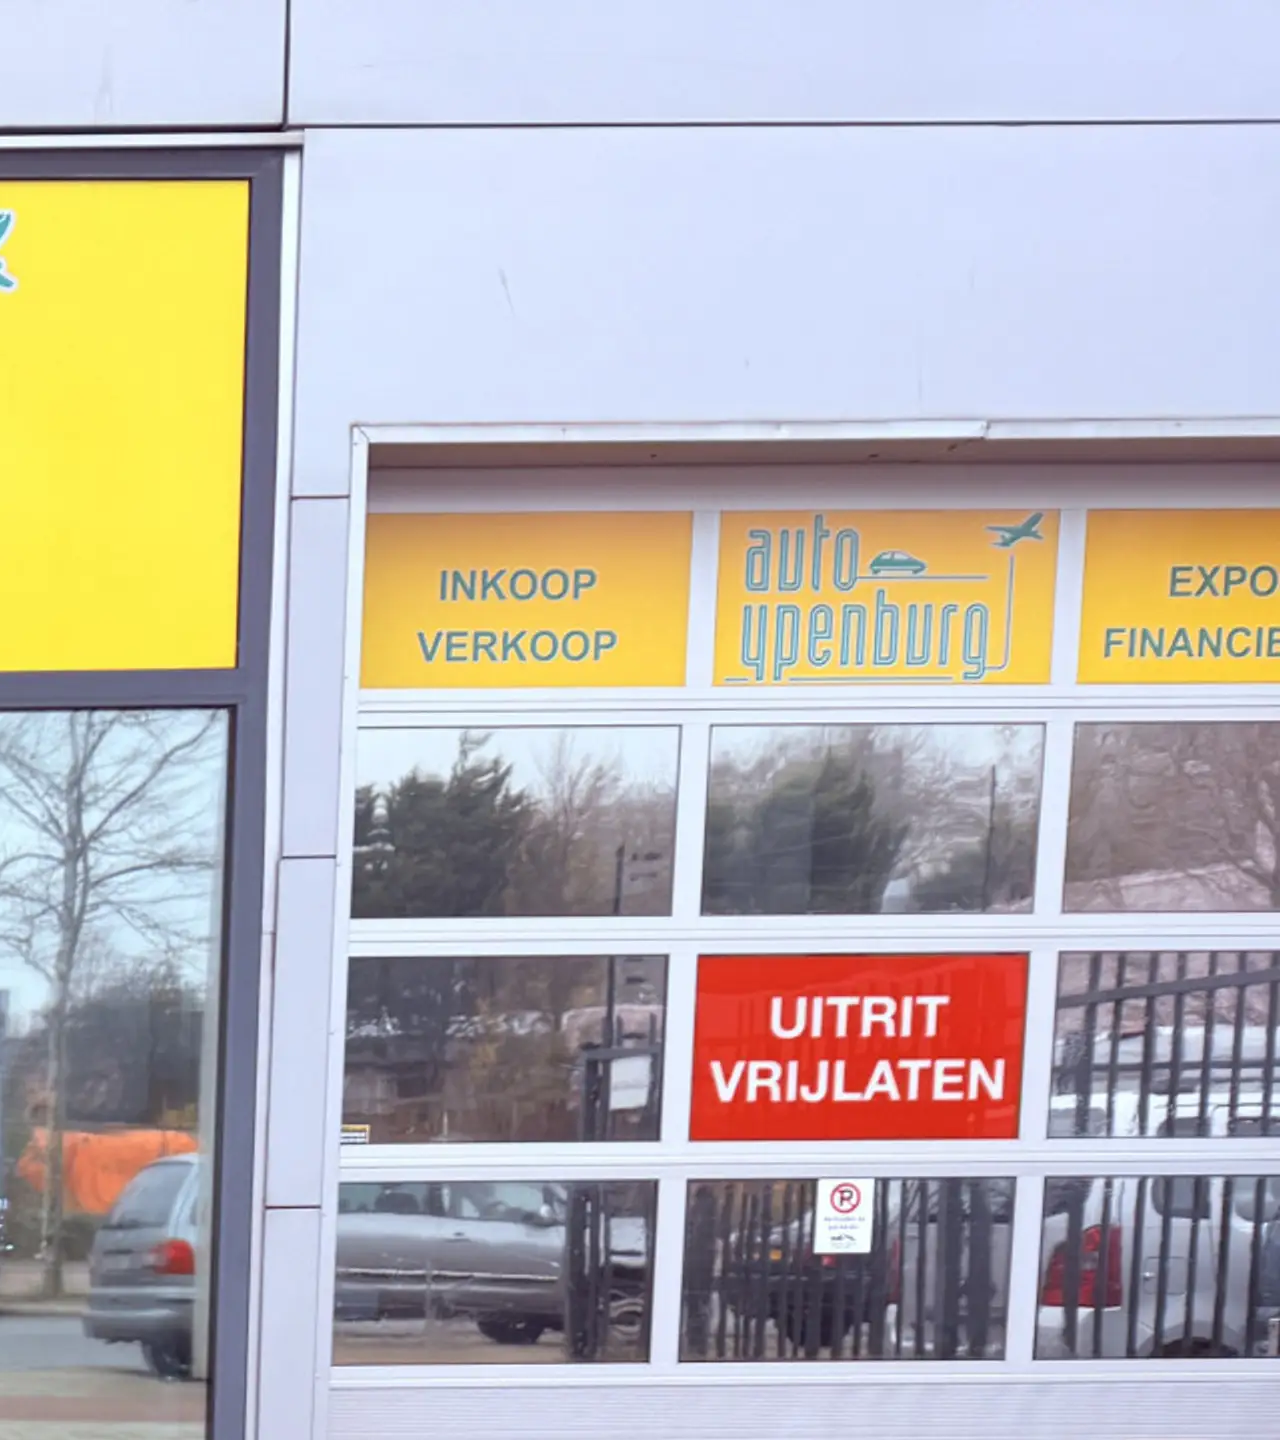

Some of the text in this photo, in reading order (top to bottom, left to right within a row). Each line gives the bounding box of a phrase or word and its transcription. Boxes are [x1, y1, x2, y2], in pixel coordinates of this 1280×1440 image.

[745, 514, 859, 591] auto
[440, 569, 597, 600] INKOOP
[1169, 565, 1279, 597] EXPO
[417, 630, 618, 662] VERKOOP
[741, 589, 989, 681] ypenburg
[770, 995, 951, 1039] UITRIT
[710, 1059, 1006, 1104] VRIJLATEN
